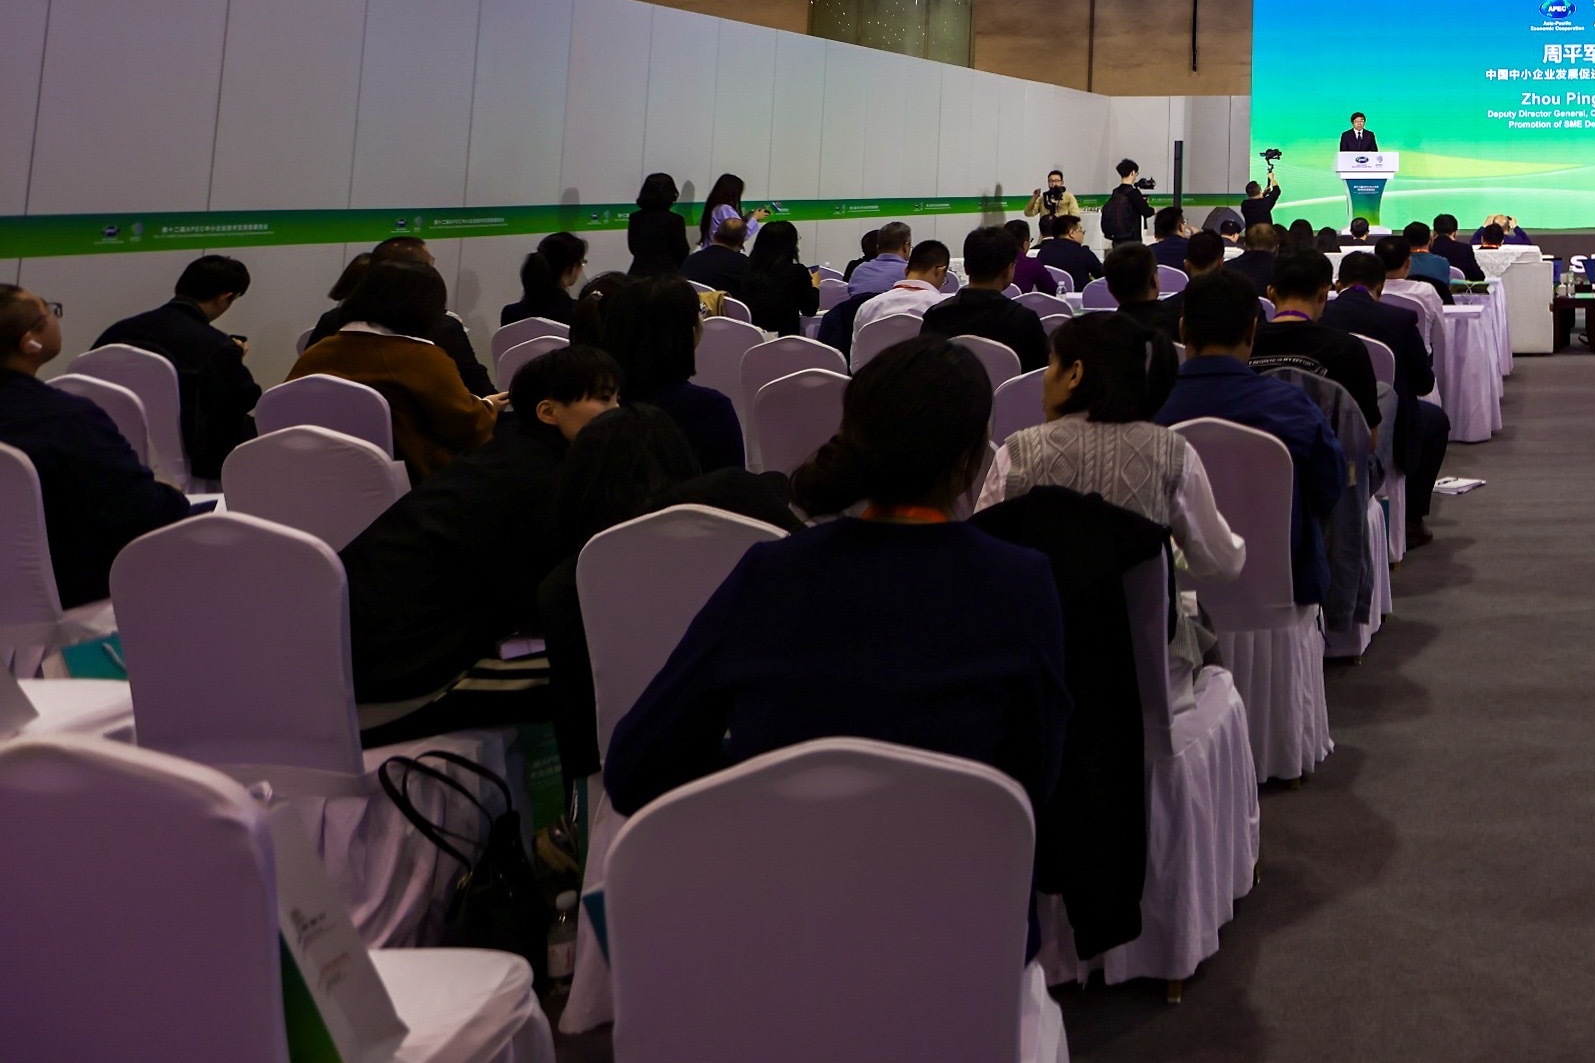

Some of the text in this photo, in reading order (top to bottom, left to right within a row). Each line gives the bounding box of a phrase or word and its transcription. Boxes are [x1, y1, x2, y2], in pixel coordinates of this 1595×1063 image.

[1521, 92, 1561, 105] Zhou
[1487, 110, 1516, 119] Deputy
[1519, 109, 1552, 117] Director
[1553, 109, 1588, 119] General,
[1508, 120, 1551, 129] Promotion
[1553, 120, 1562, 128] of
[1564, 120, 1582, 128] SME
